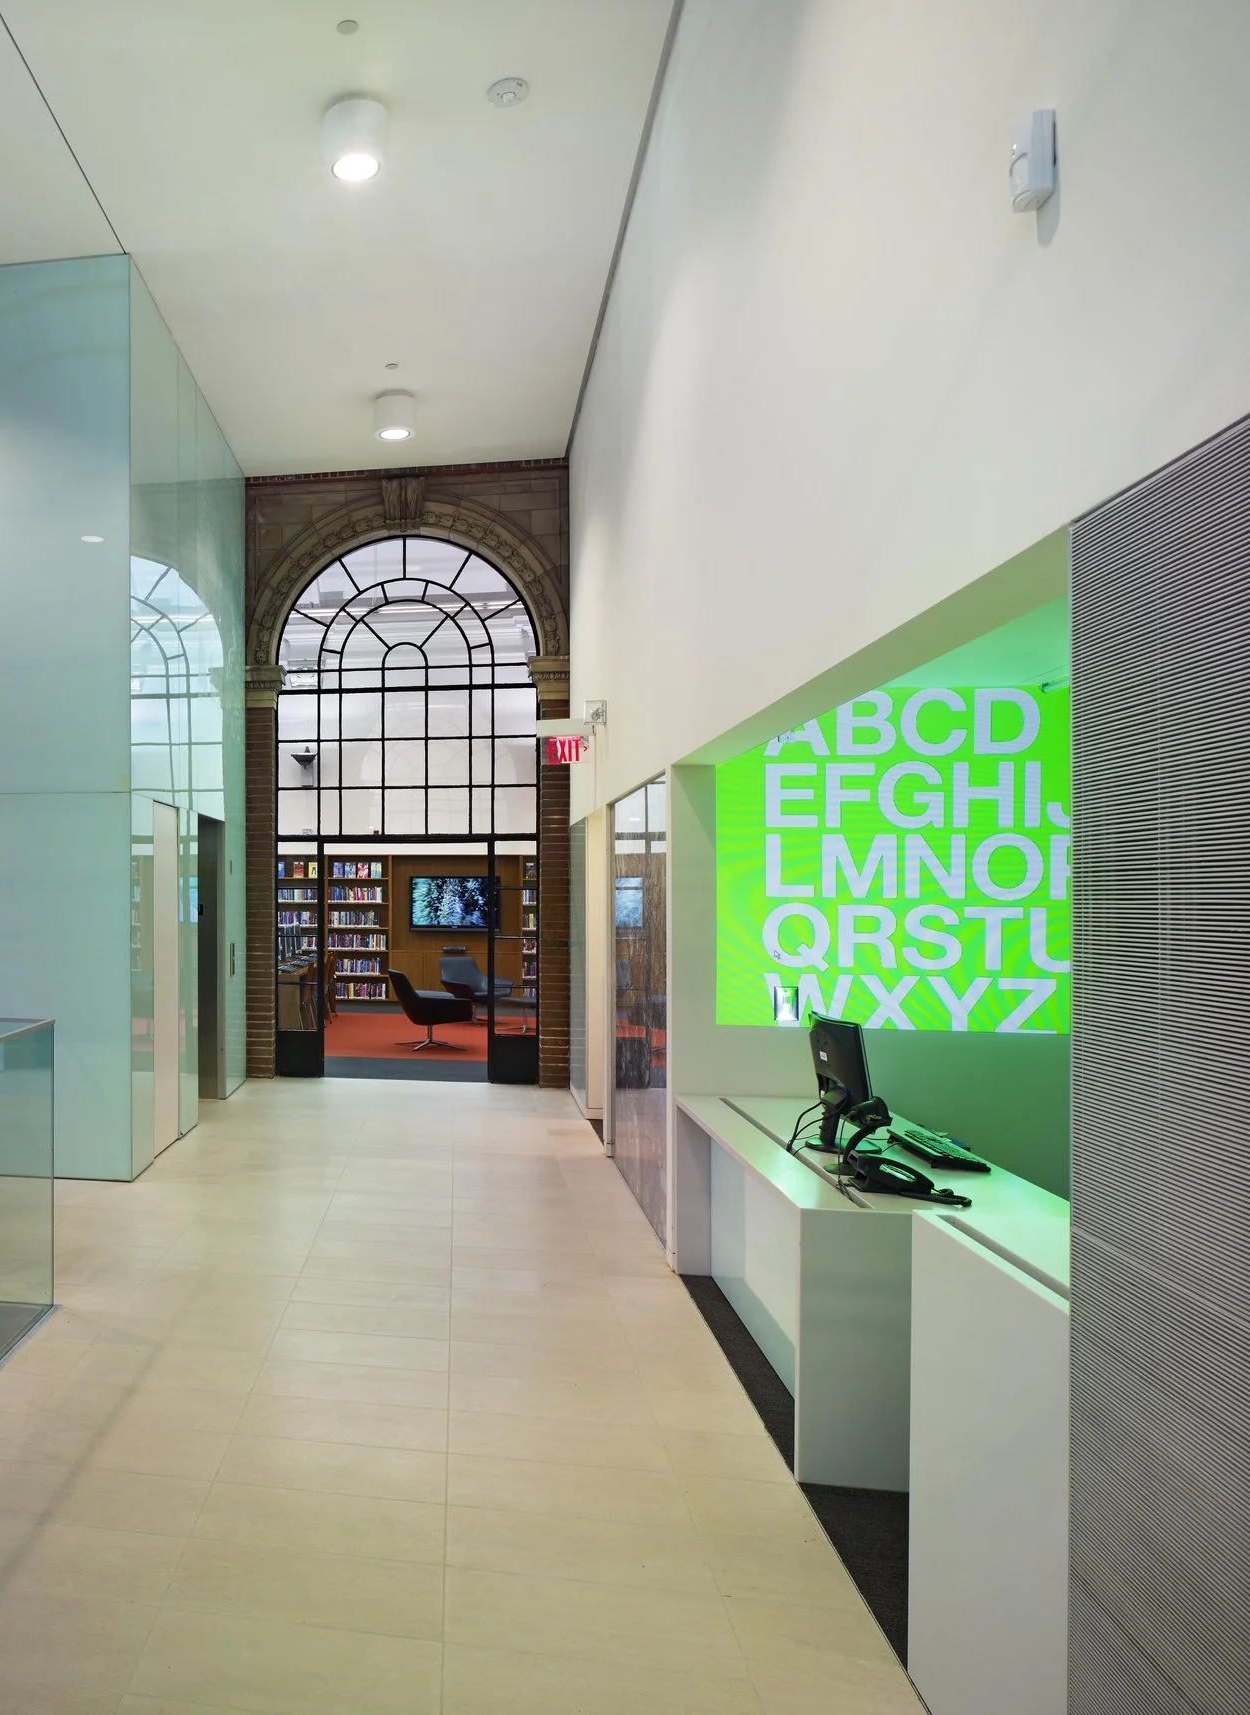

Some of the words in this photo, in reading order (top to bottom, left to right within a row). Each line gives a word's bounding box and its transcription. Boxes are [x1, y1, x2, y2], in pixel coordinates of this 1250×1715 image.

[547, 737, 582, 763] EXIT
[763, 687, 1041, 757] ABCD
[762, 902, 1071, 973] QRSTU
[763, 972, 1057, 1034] WXYZ
